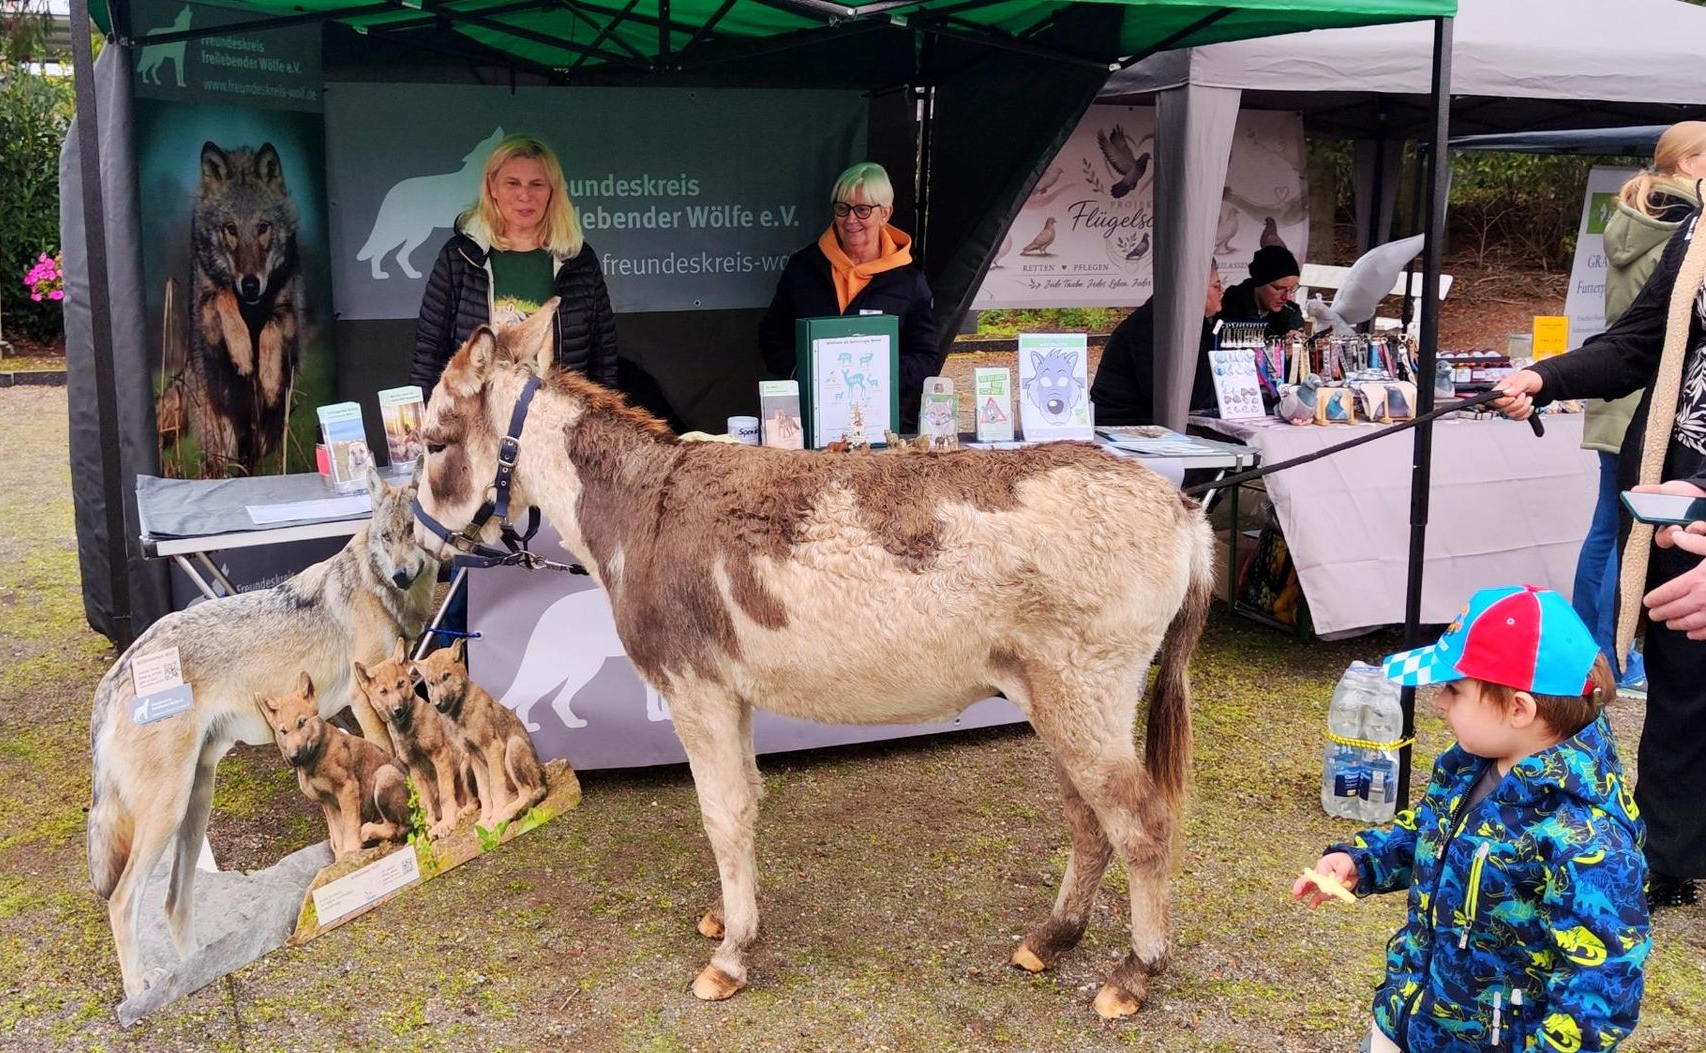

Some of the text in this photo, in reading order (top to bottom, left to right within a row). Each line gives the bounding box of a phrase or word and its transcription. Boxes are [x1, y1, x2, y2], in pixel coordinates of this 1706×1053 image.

[569, 173, 699, 197] undeskreis
[685, 204, 753, 228] Wölfe
[760, 205, 800, 227] e.V.
[1110, 200, 1152, 209] PROJEK
[1067, 200, 1153, 239] Flügelsc
[602, 251, 790, 276] freundeskreis-wo
[1022, 264, 1055, 272] RETTEN
[1073, 264, 1109, 272] PFLEGEN
[1587, 254, 1607, 269] GRA
